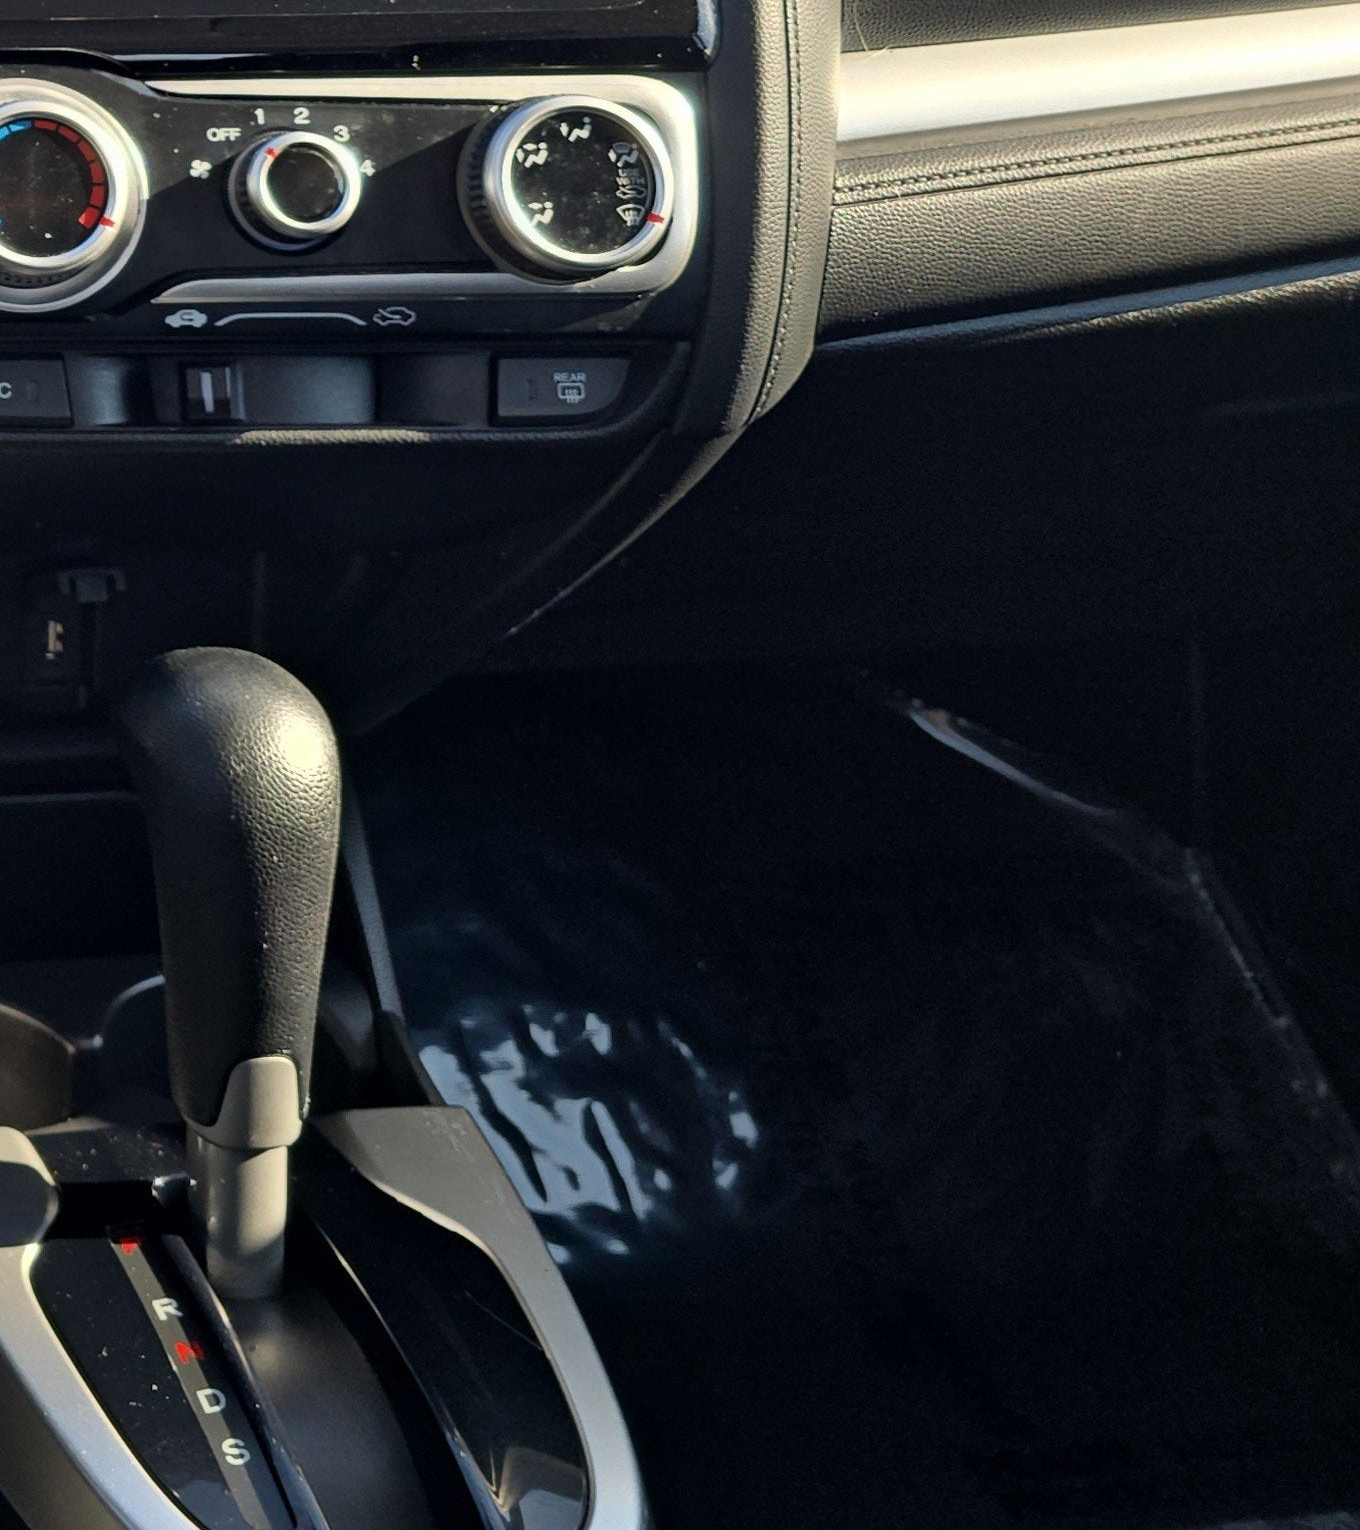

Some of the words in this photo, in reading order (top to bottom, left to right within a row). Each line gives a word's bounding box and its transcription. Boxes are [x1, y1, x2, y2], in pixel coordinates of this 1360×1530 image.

[254, 108, 265, 125] 1
[293, 107, 311, 125] 2
[206, 127, 242, 142] OFF
[333, 125, 350, 142] 3
[359, 159, 376, 177] 4
[553, 372, 587, 383] REAR
[152, 1297, 183, 1321] R
[196, 1388, 226, 1414] D
[222, 1438, 251, 1465] S
